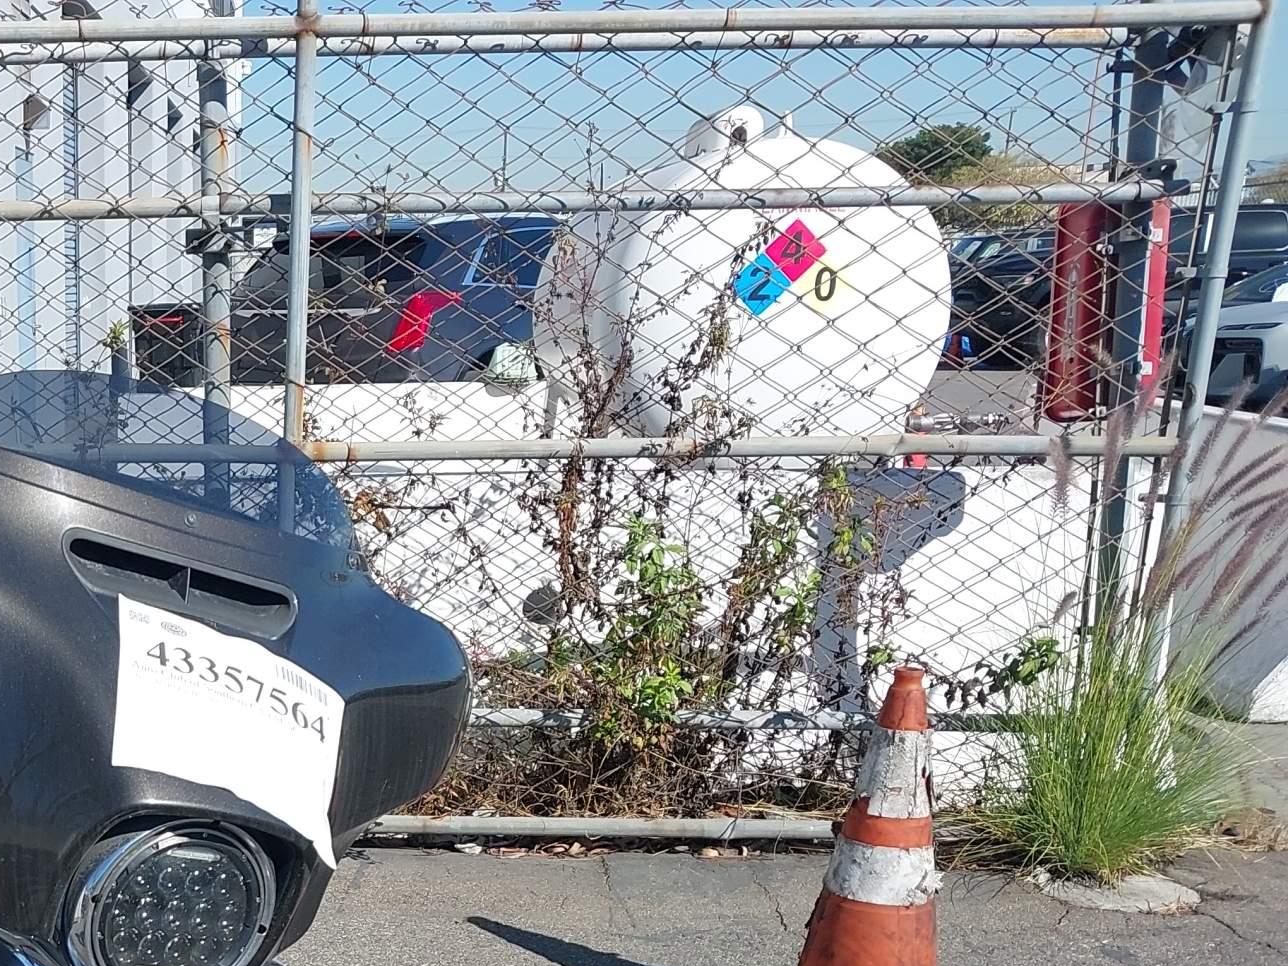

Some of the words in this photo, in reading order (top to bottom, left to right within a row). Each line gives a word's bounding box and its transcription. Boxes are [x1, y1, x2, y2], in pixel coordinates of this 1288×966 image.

[780, 230, 807, 265] 4
[747, 266, 771, 303] 2
[814, 266, 837, 302] 0
[146, 641, 327, 743] 43357564
